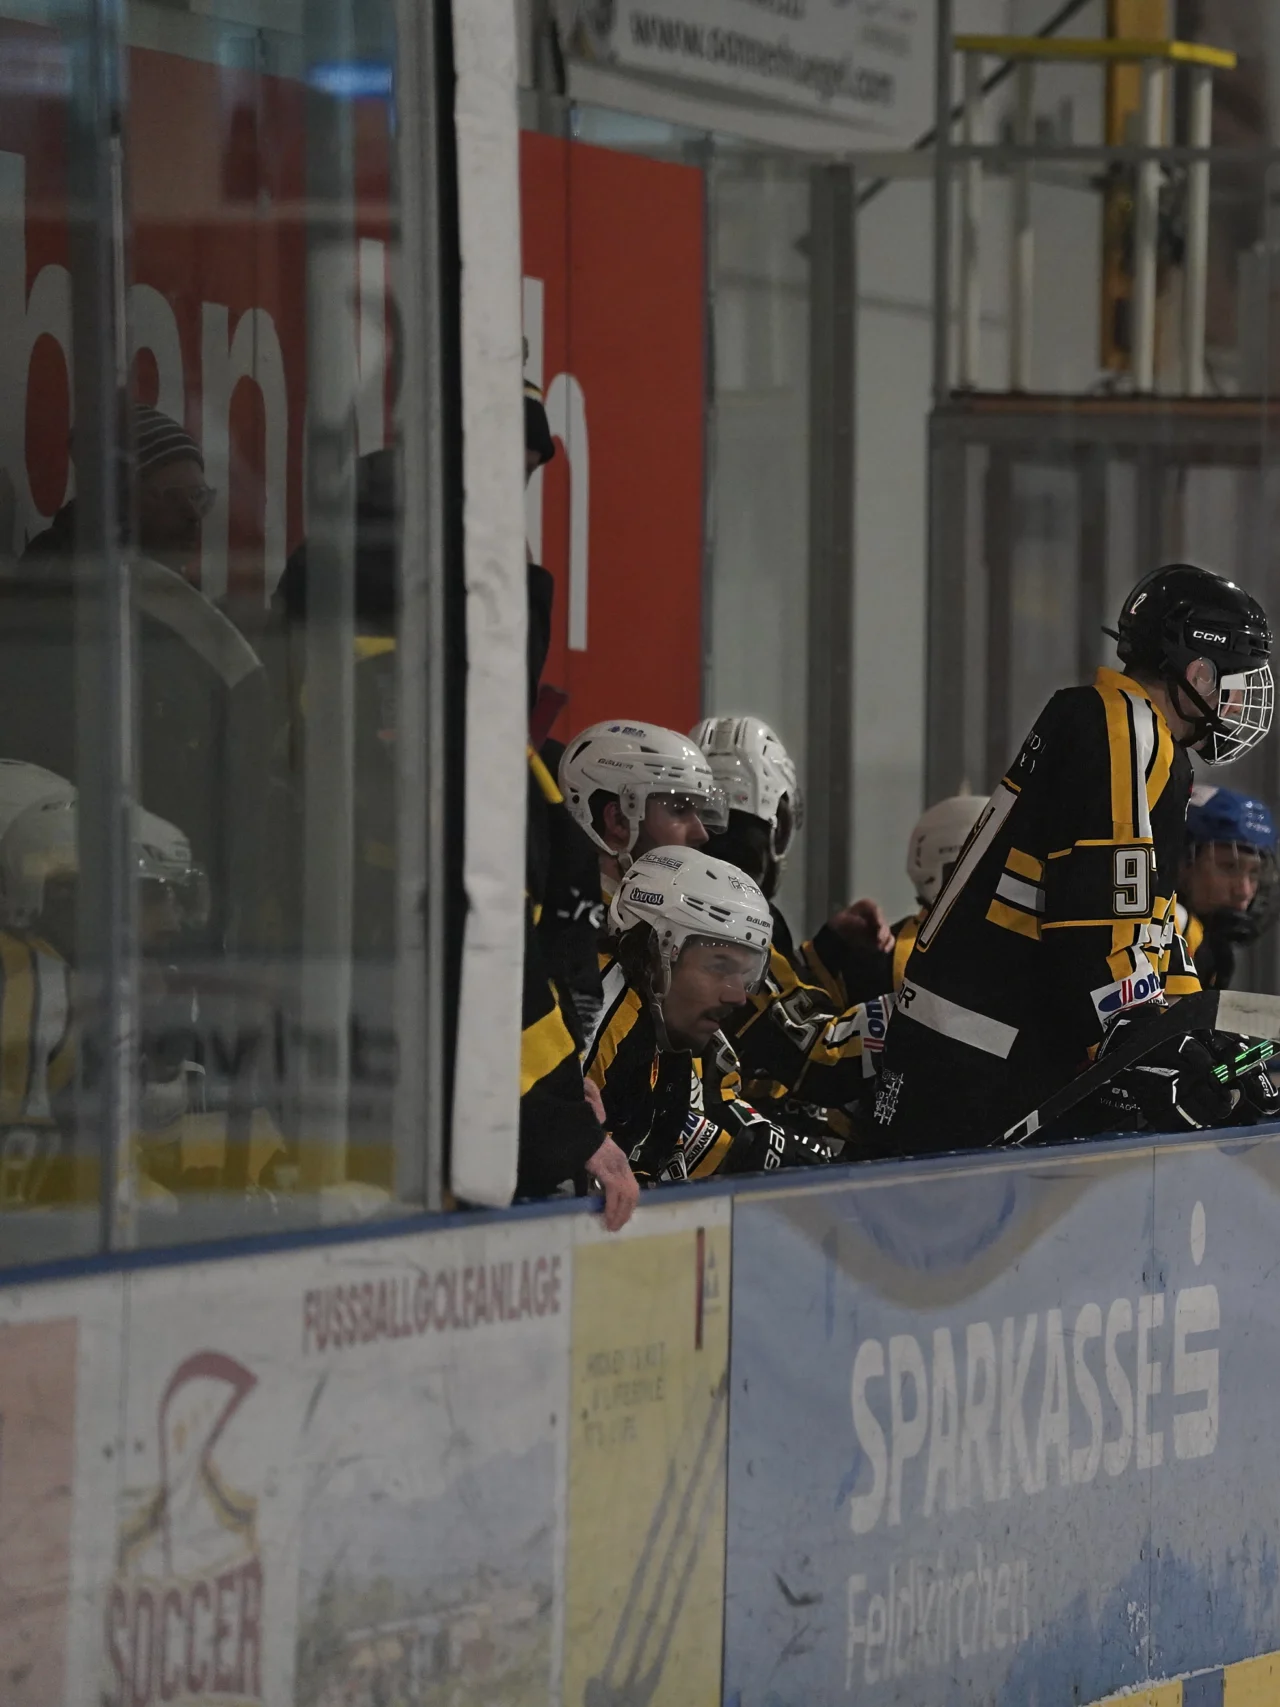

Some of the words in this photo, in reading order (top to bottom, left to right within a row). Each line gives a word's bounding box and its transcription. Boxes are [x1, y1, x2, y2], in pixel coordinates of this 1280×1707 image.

[1192, 630, 1227, 644] CCM
[745, 915, 771, 928] BAUER
[303, 1256, 561, 1354] FUSSBALLGOLFANLAGE
[849, 1291, 1165, 1535] SPARKASSE
[104, 1556, 263, 1707] SOCCER
